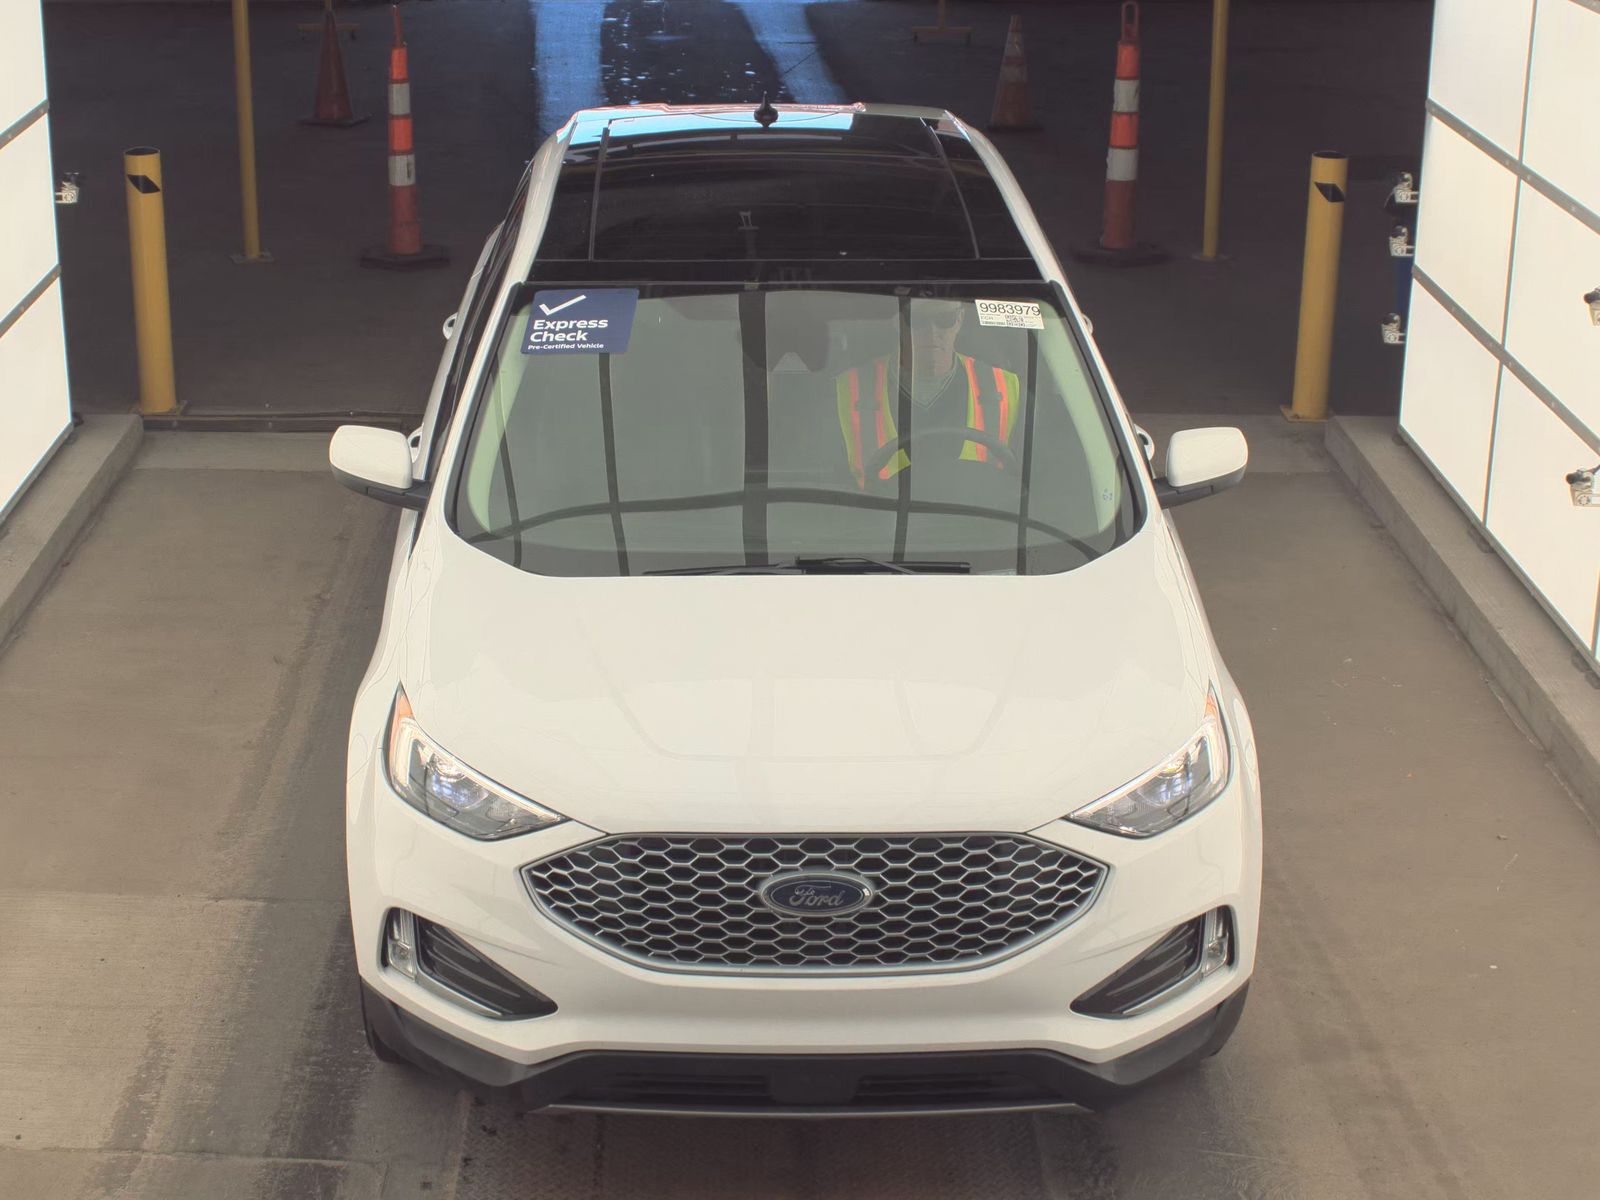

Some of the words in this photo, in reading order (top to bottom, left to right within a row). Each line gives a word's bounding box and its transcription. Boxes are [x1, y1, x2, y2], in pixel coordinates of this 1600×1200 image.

[980, 302, 1041, 316] 9983979
[533, 319, 609, 331] Express
[530, 330, 588, 342] Check
[788, 884, 846, 906] Ford
